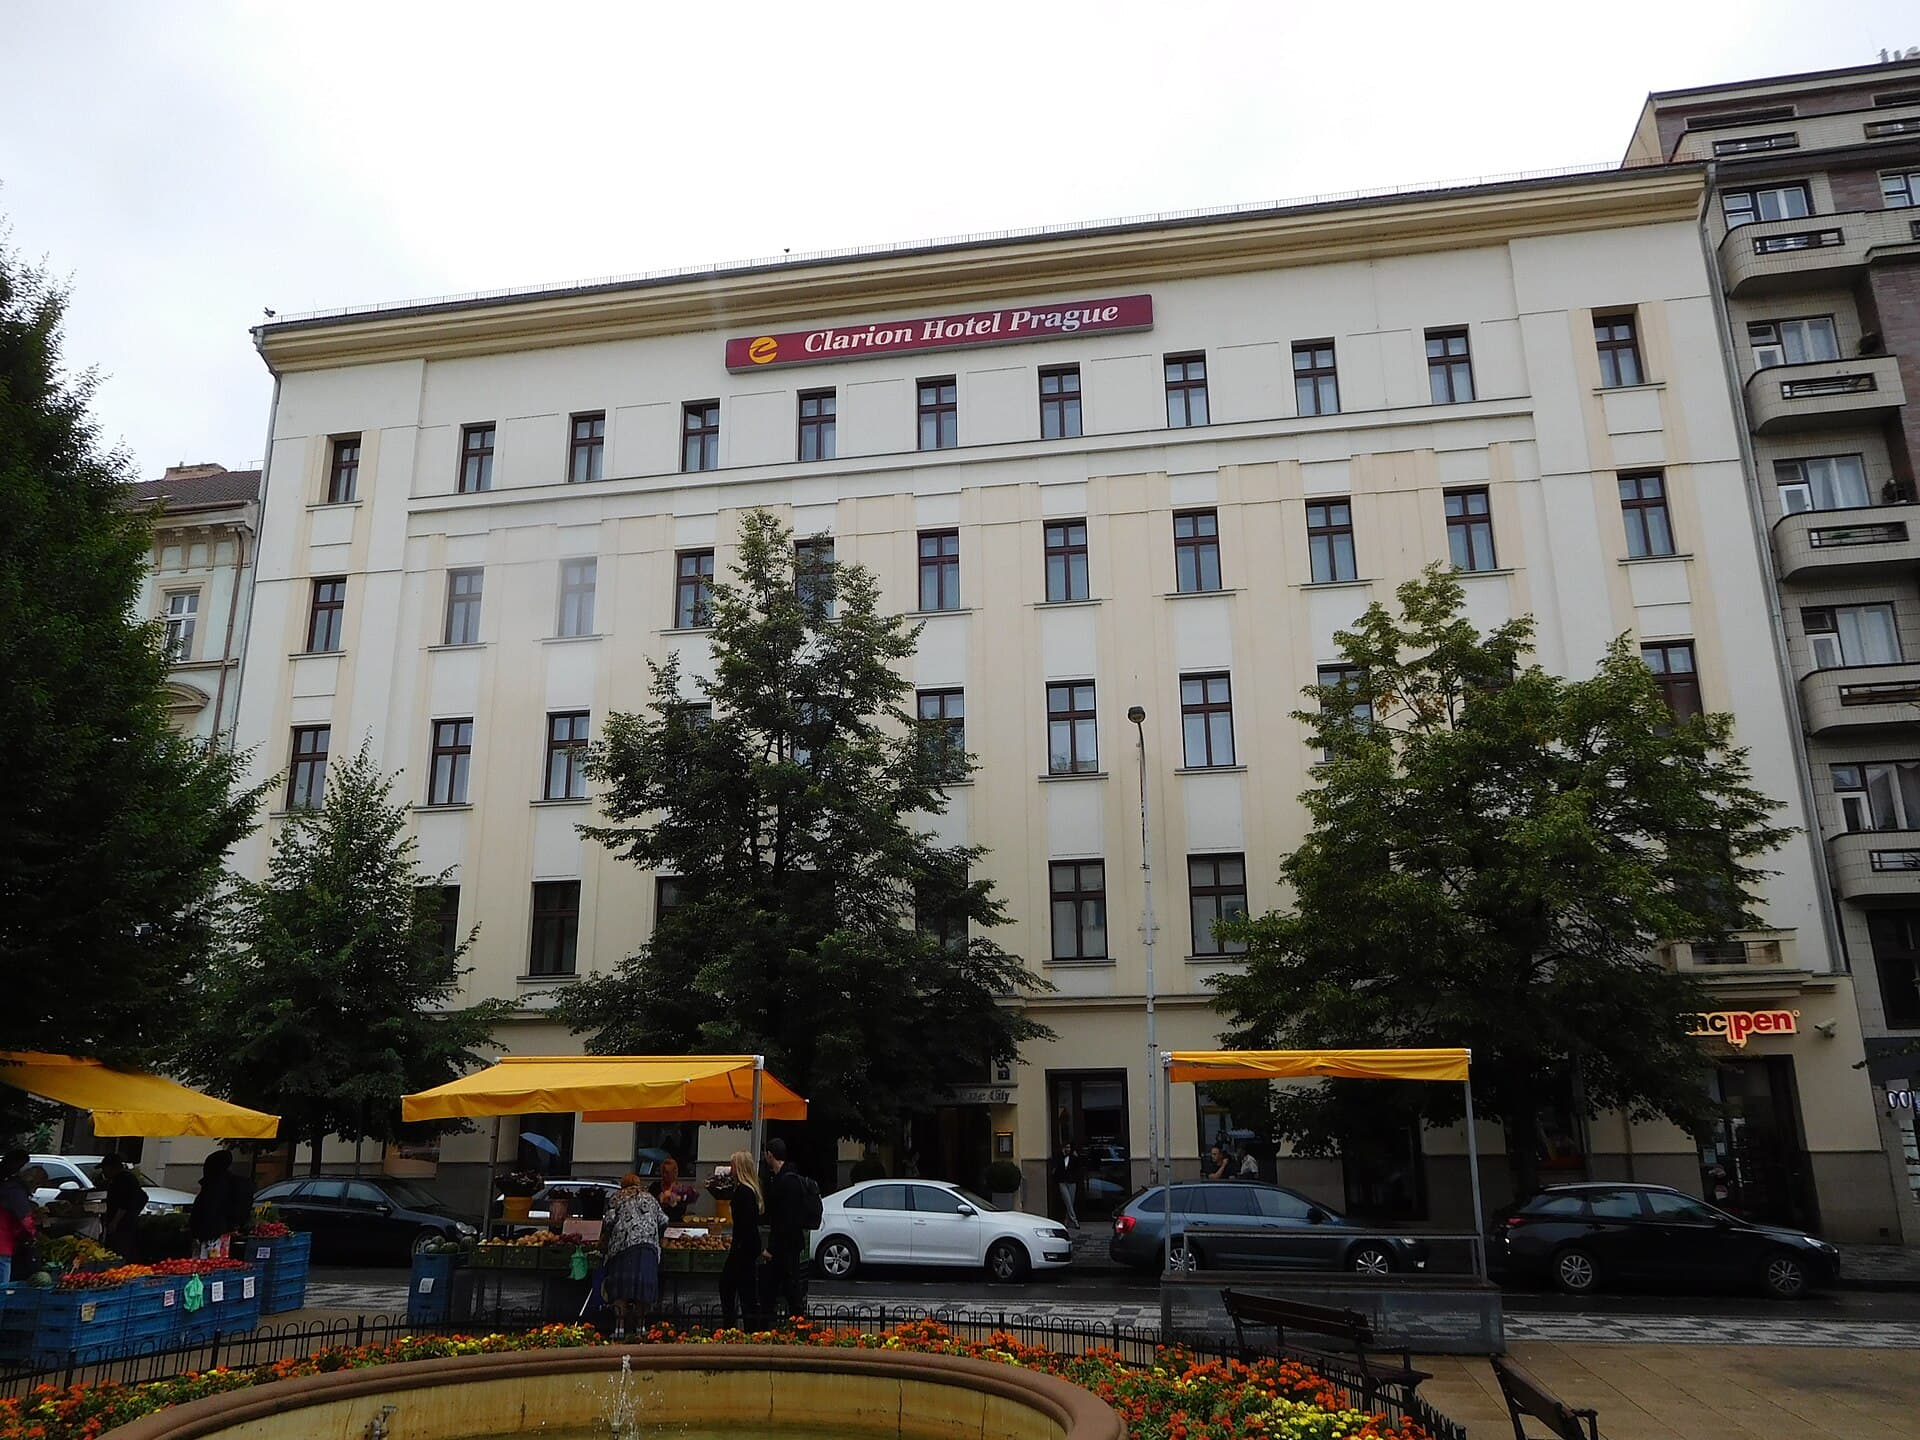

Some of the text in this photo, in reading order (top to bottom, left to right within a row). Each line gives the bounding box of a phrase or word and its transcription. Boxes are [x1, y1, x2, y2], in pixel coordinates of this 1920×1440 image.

[804, 305, 1119, 353] Clarion Hotel Prague
